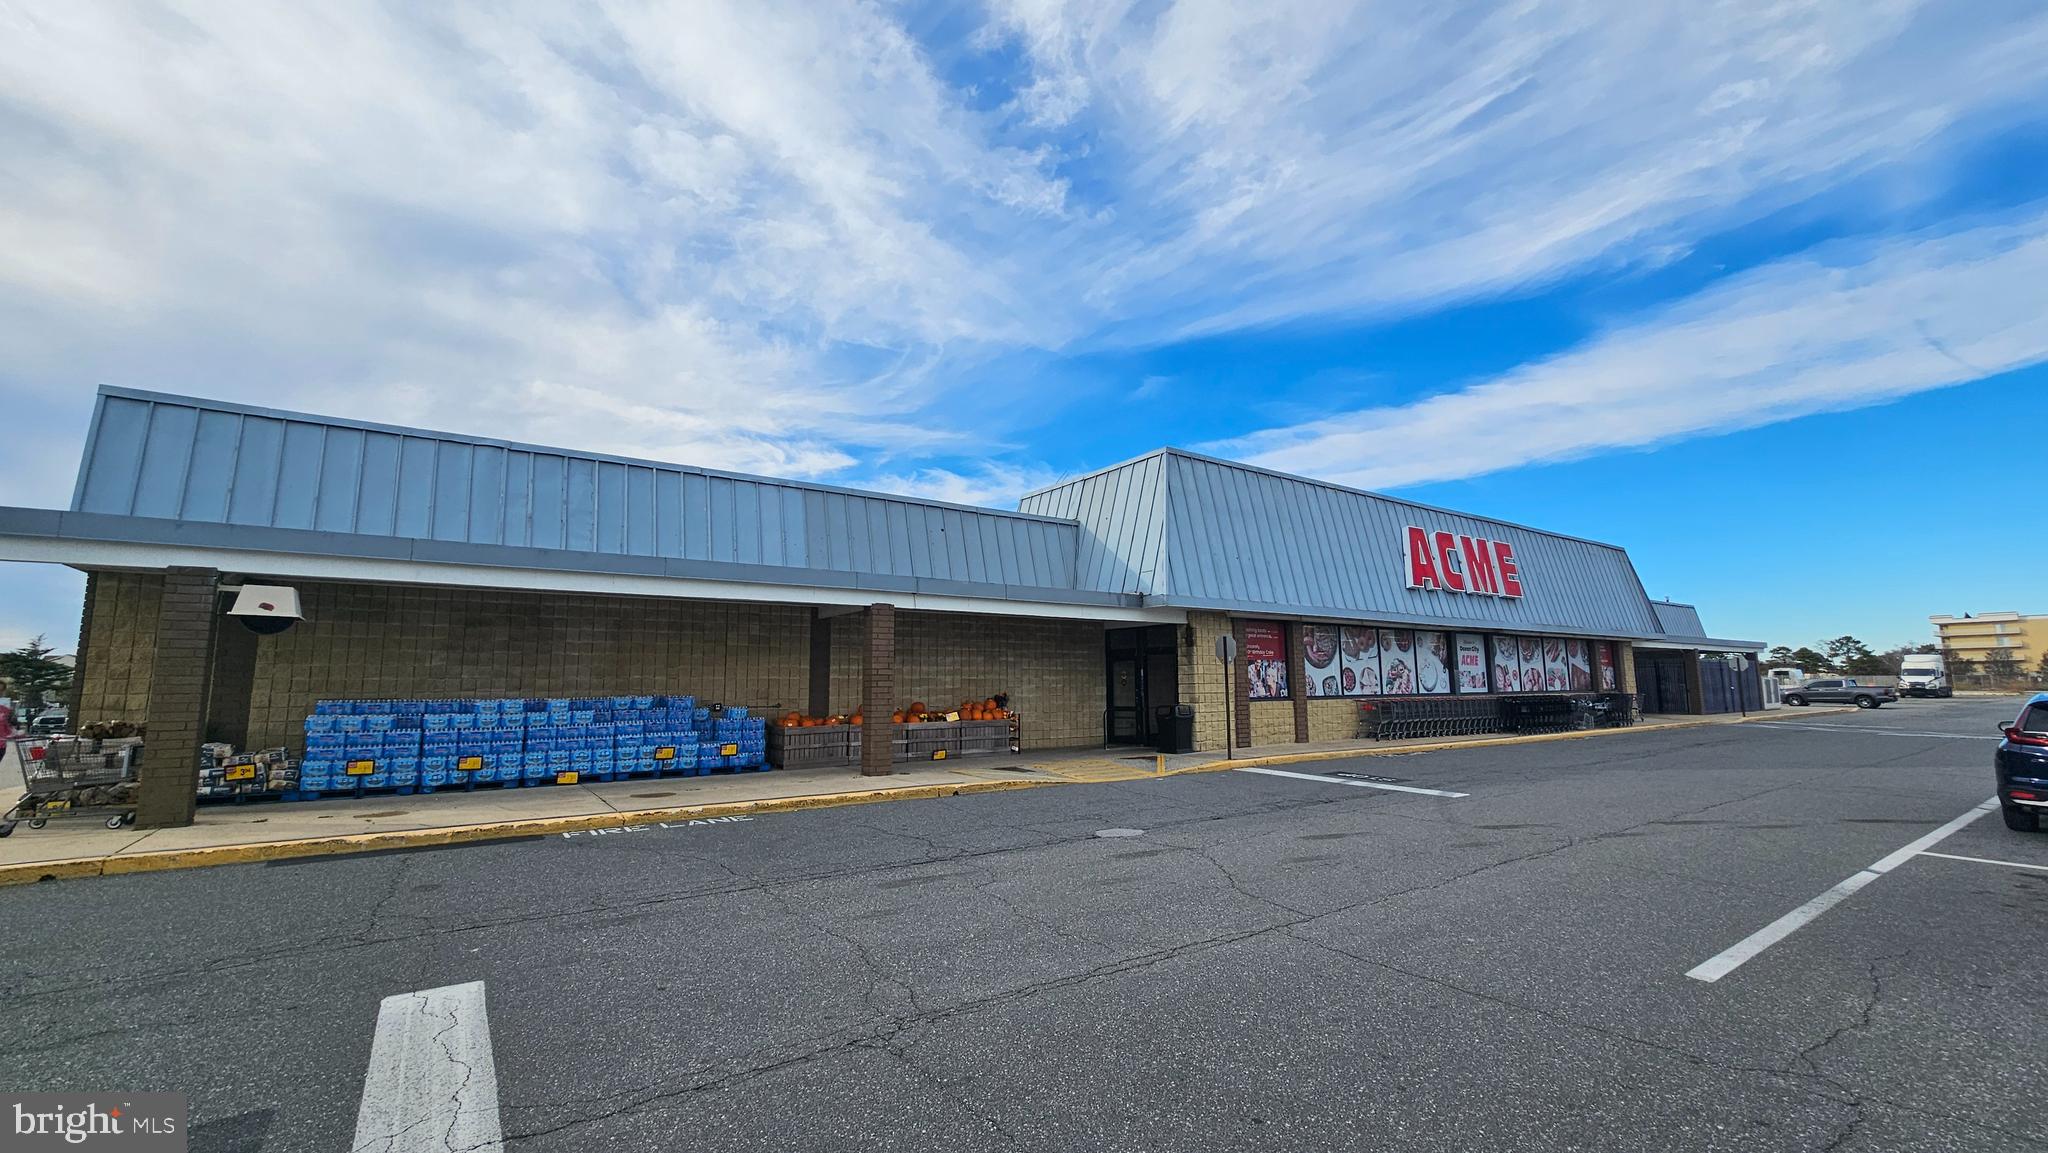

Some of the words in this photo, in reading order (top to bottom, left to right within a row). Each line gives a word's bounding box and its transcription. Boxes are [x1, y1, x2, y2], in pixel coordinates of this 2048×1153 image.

[1402, 526, 1523, 598] ACME
[1461, 654, 1479, 666] ACME
[562, 824, 649, 839] FIRE
[659, 815, 754, 829] LANE
